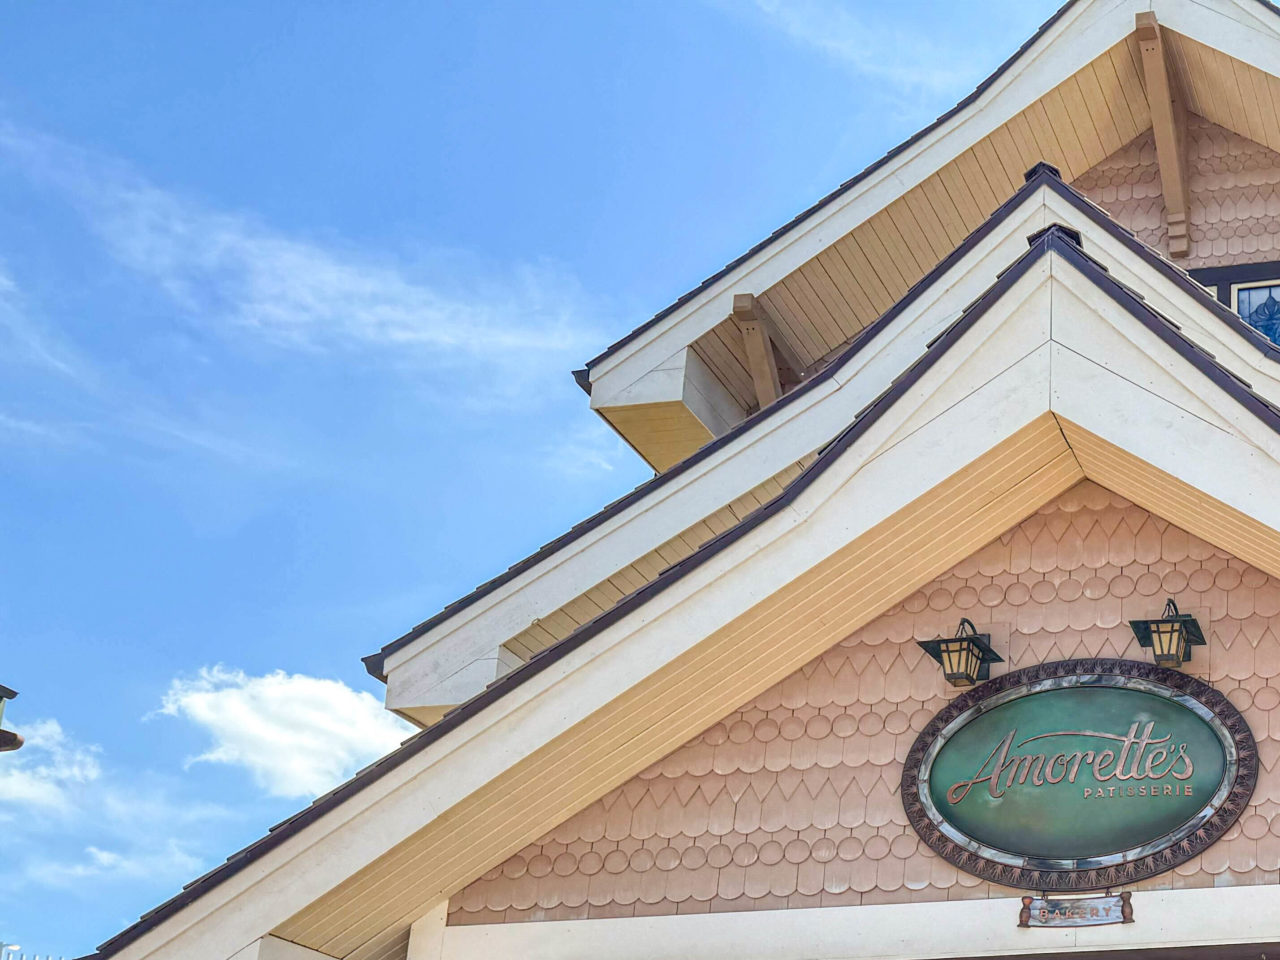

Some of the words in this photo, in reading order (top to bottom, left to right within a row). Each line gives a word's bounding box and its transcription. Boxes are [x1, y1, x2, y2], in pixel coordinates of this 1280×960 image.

[947, 721, 1194, 805] Amorette's
[1083, 784, 1193, 799] PATISSERIE
[1040, 906, 1112, 919] BAKERY
